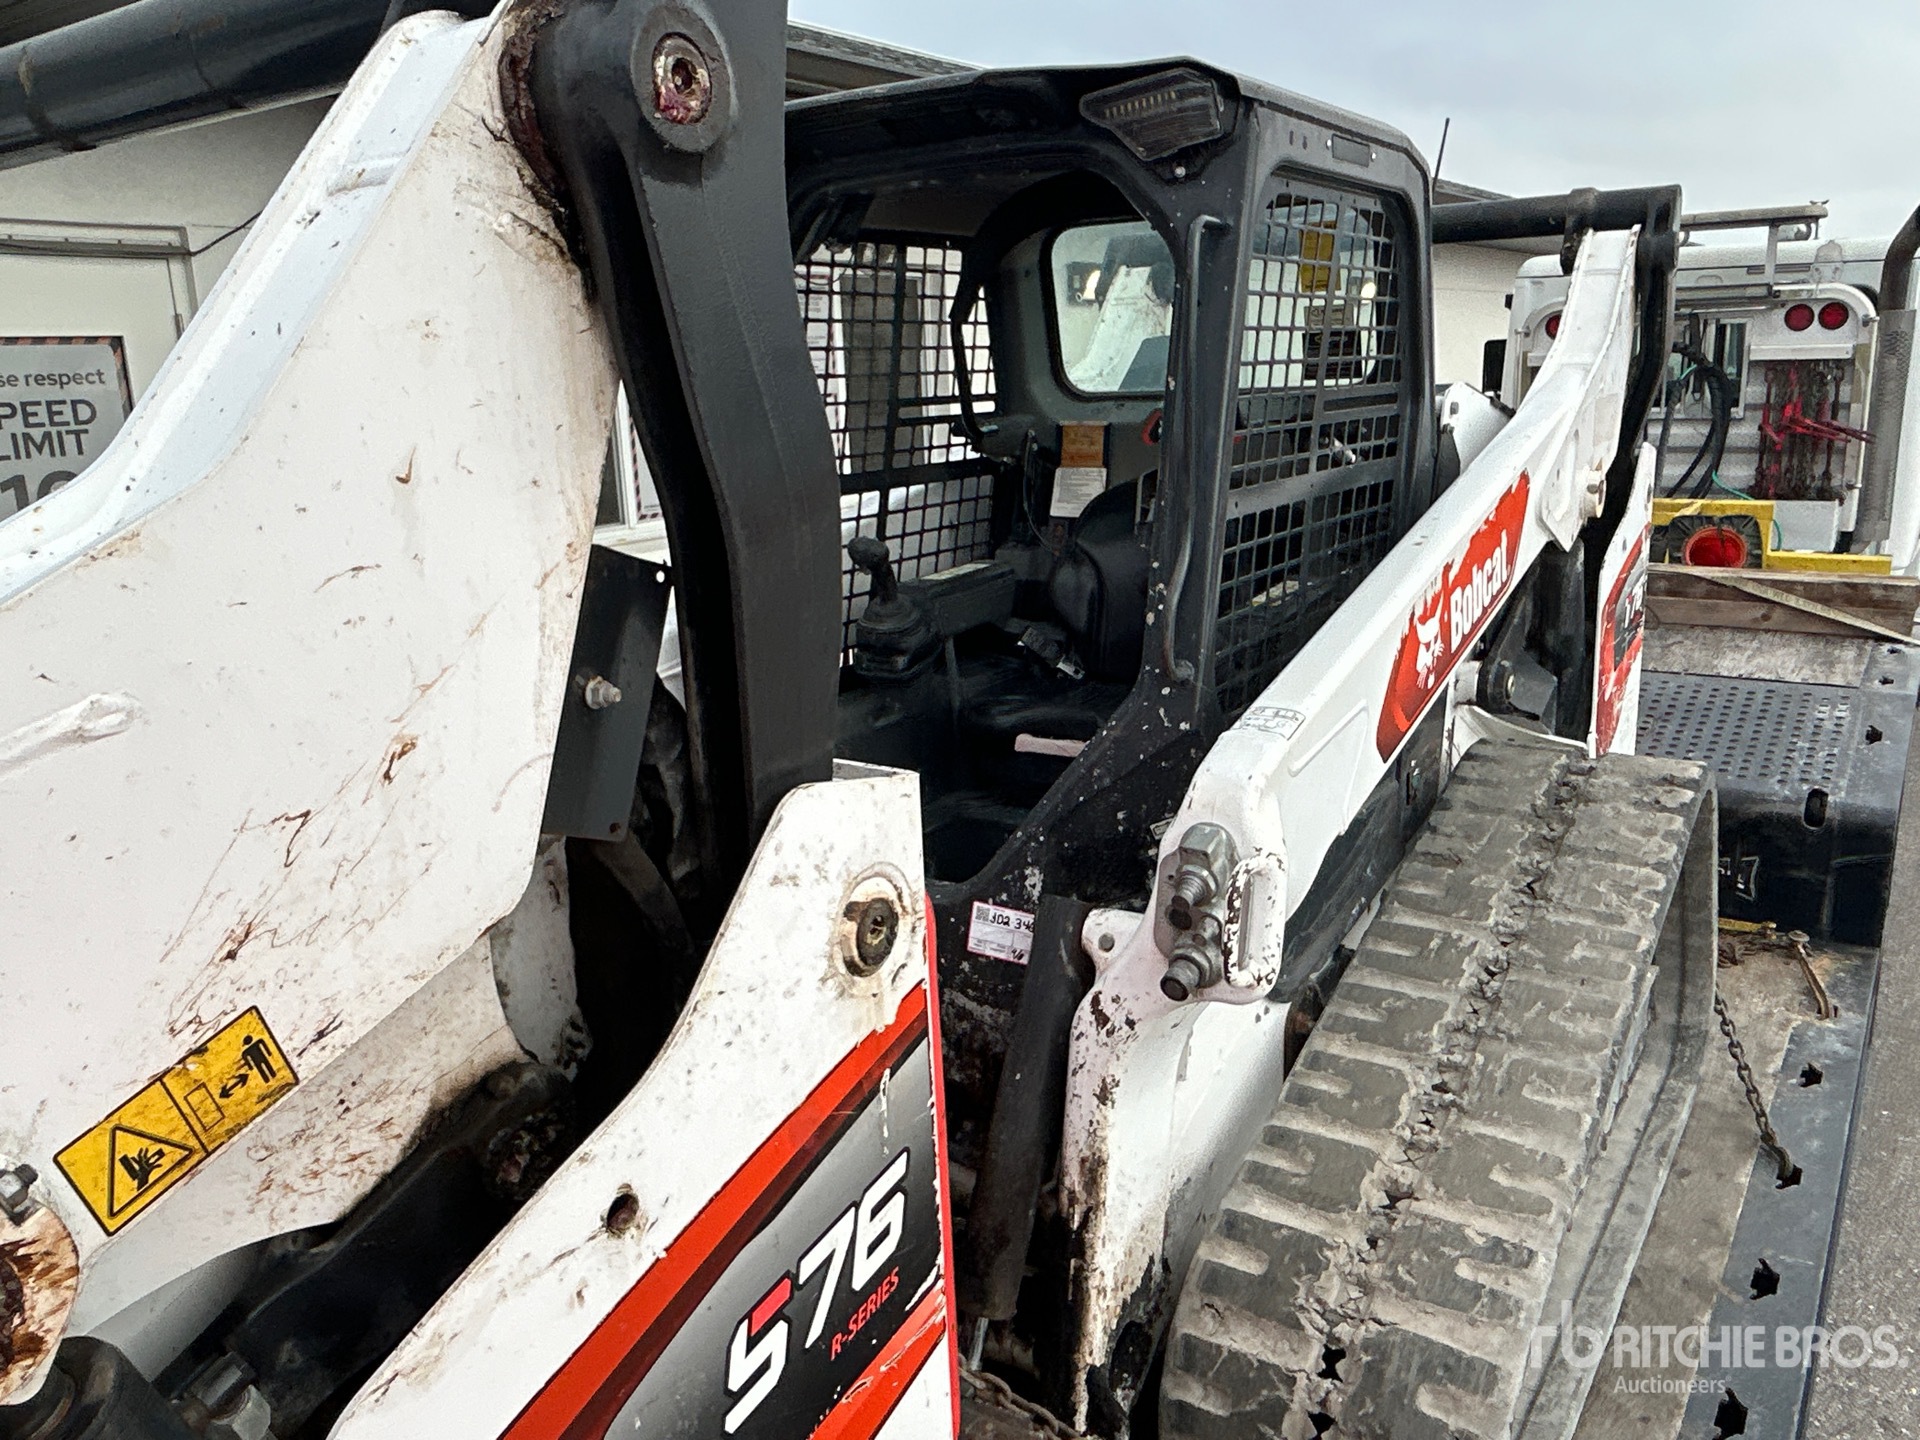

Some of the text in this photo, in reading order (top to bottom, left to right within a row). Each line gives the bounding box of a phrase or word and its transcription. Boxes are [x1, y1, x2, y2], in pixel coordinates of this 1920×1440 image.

[25, 369, 106, 389] respect
[1450, 528, 1508, 653] Bobcat
[724, 1149, 908, 1434] S76
[830, 1266, 900, 1361] R-SERIES
